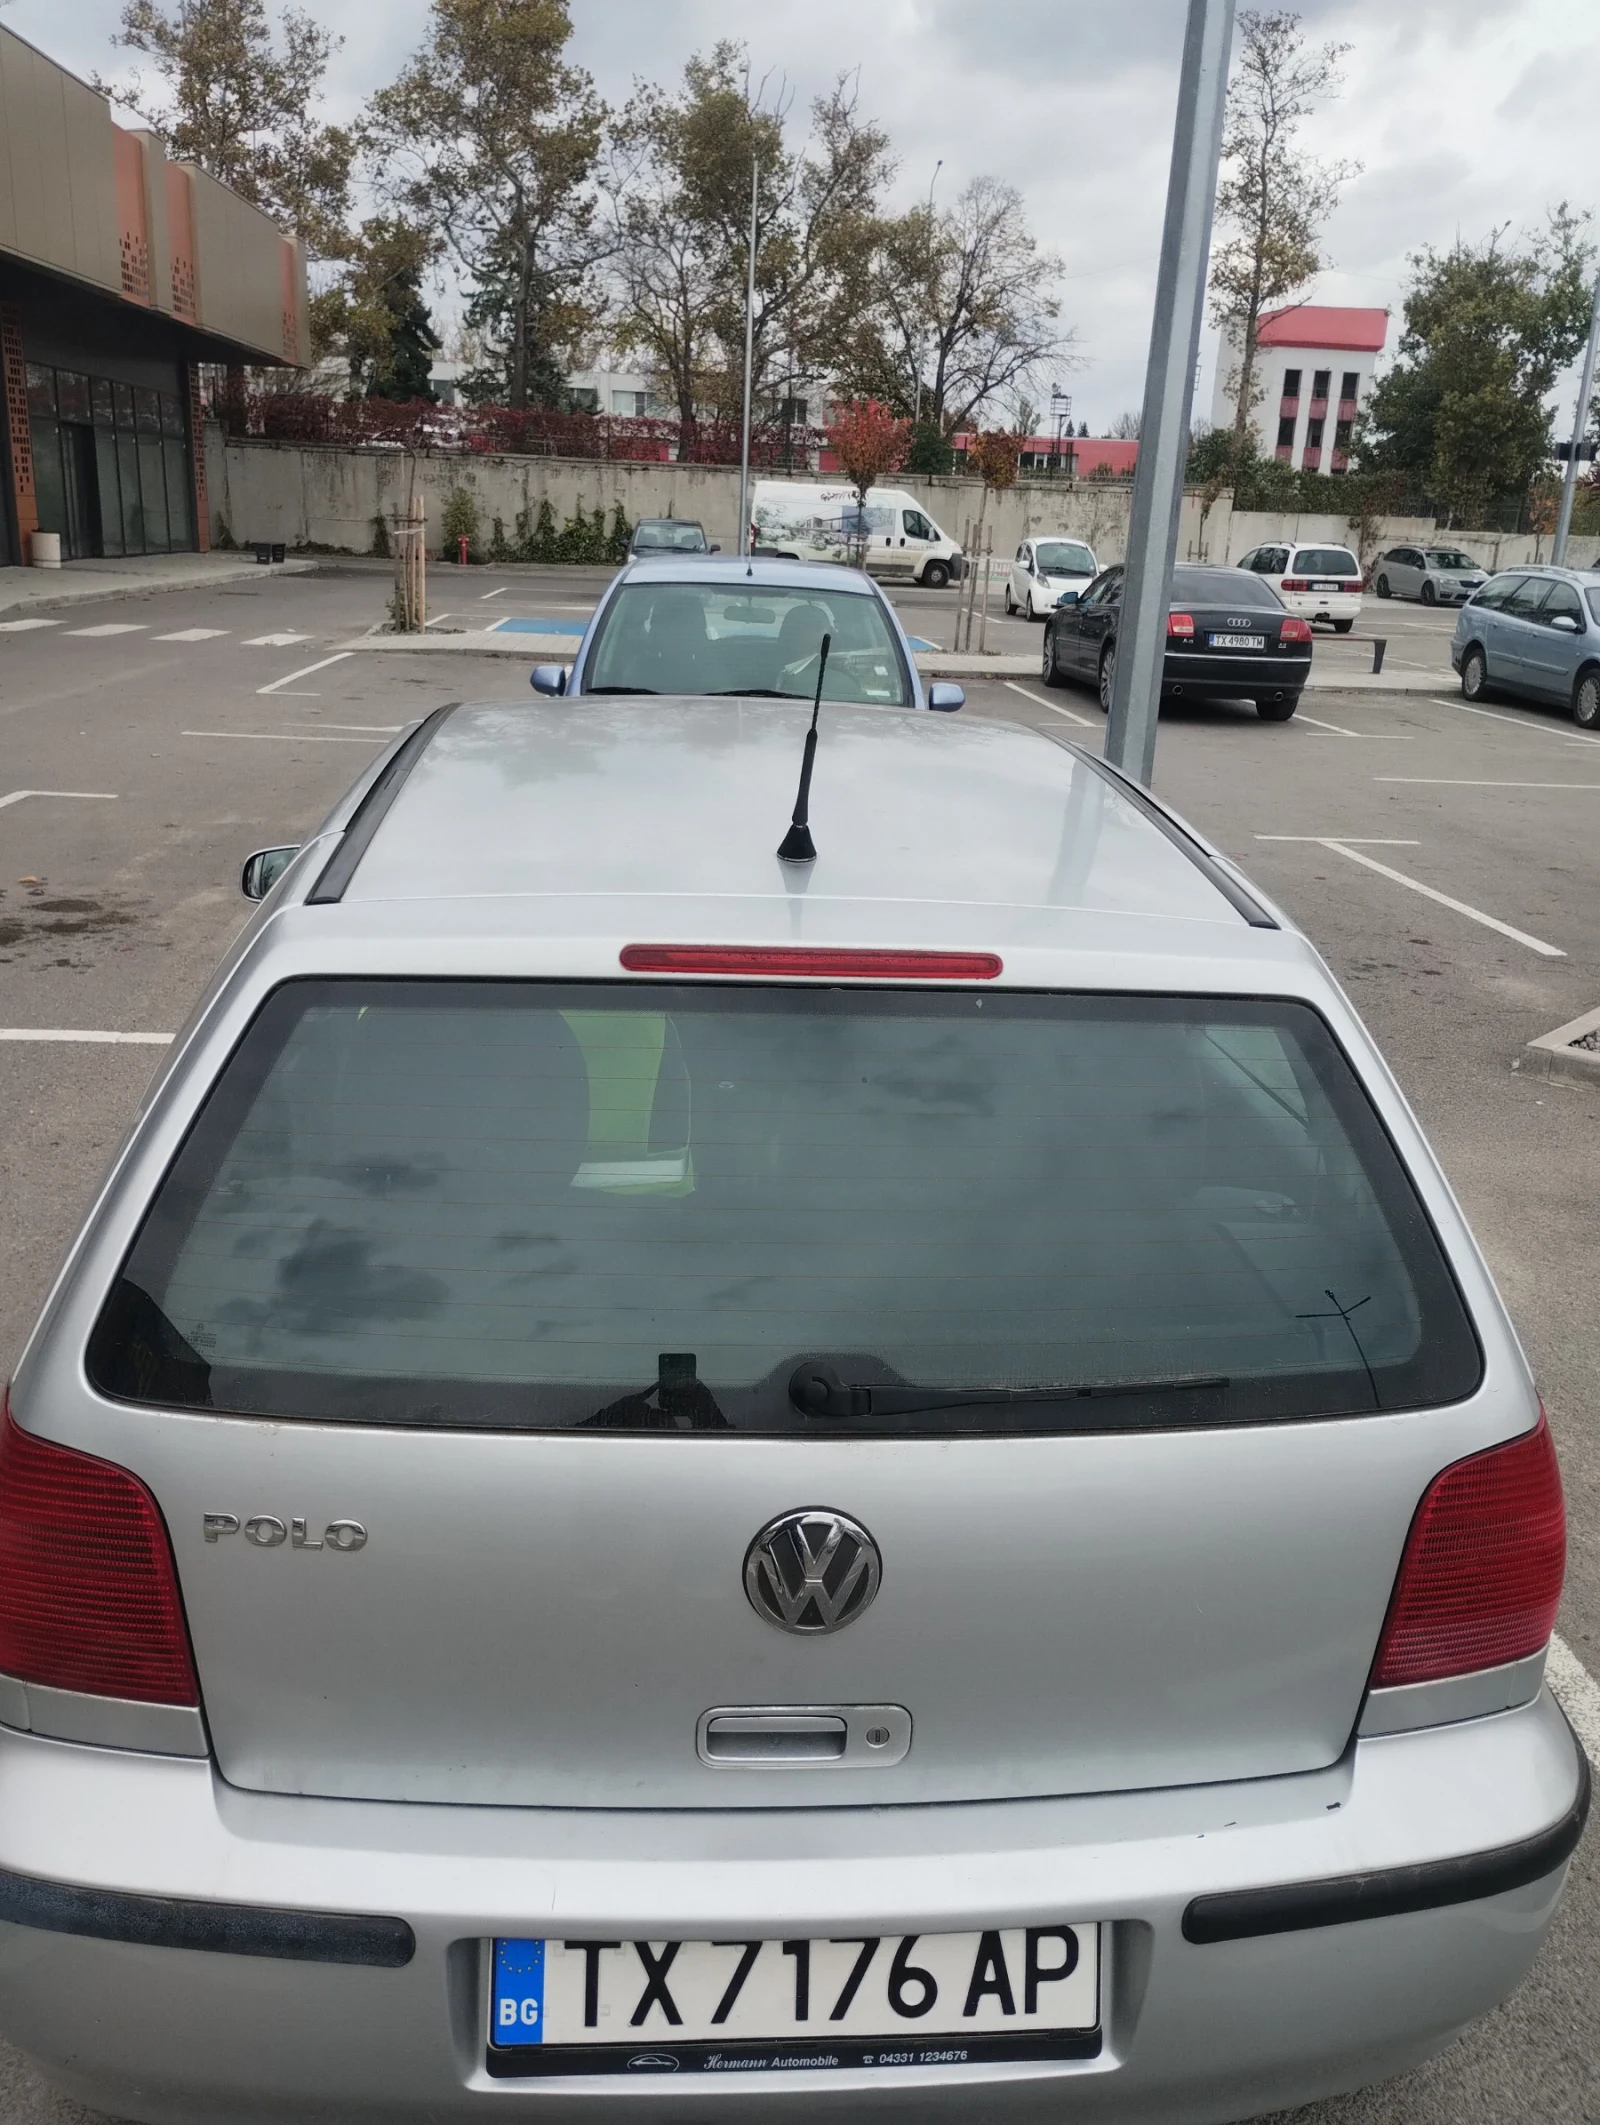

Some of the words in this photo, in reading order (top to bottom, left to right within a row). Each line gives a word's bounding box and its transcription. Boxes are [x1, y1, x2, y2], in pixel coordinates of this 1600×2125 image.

[1215, 635, 1228, 646] TX
[1229, 636, 1250, 647] 4980
[1251, 637, 1264, 648] TM
[203, 1511, 368, 1551] POLO
[564, 1940, 684, 2027] TX
[710, 1934, 938, 2024] 7176
[962, 1924, 1079, 2017] AP
[499, 1998, 538, 2025] BG
[703, 2053, 768, 2069] Hermann
[771, 2055, 839, 2068] Automobile
[879, 2052, 914, 2064] 04331
[919, 2050, 968, 2062] 1234676
